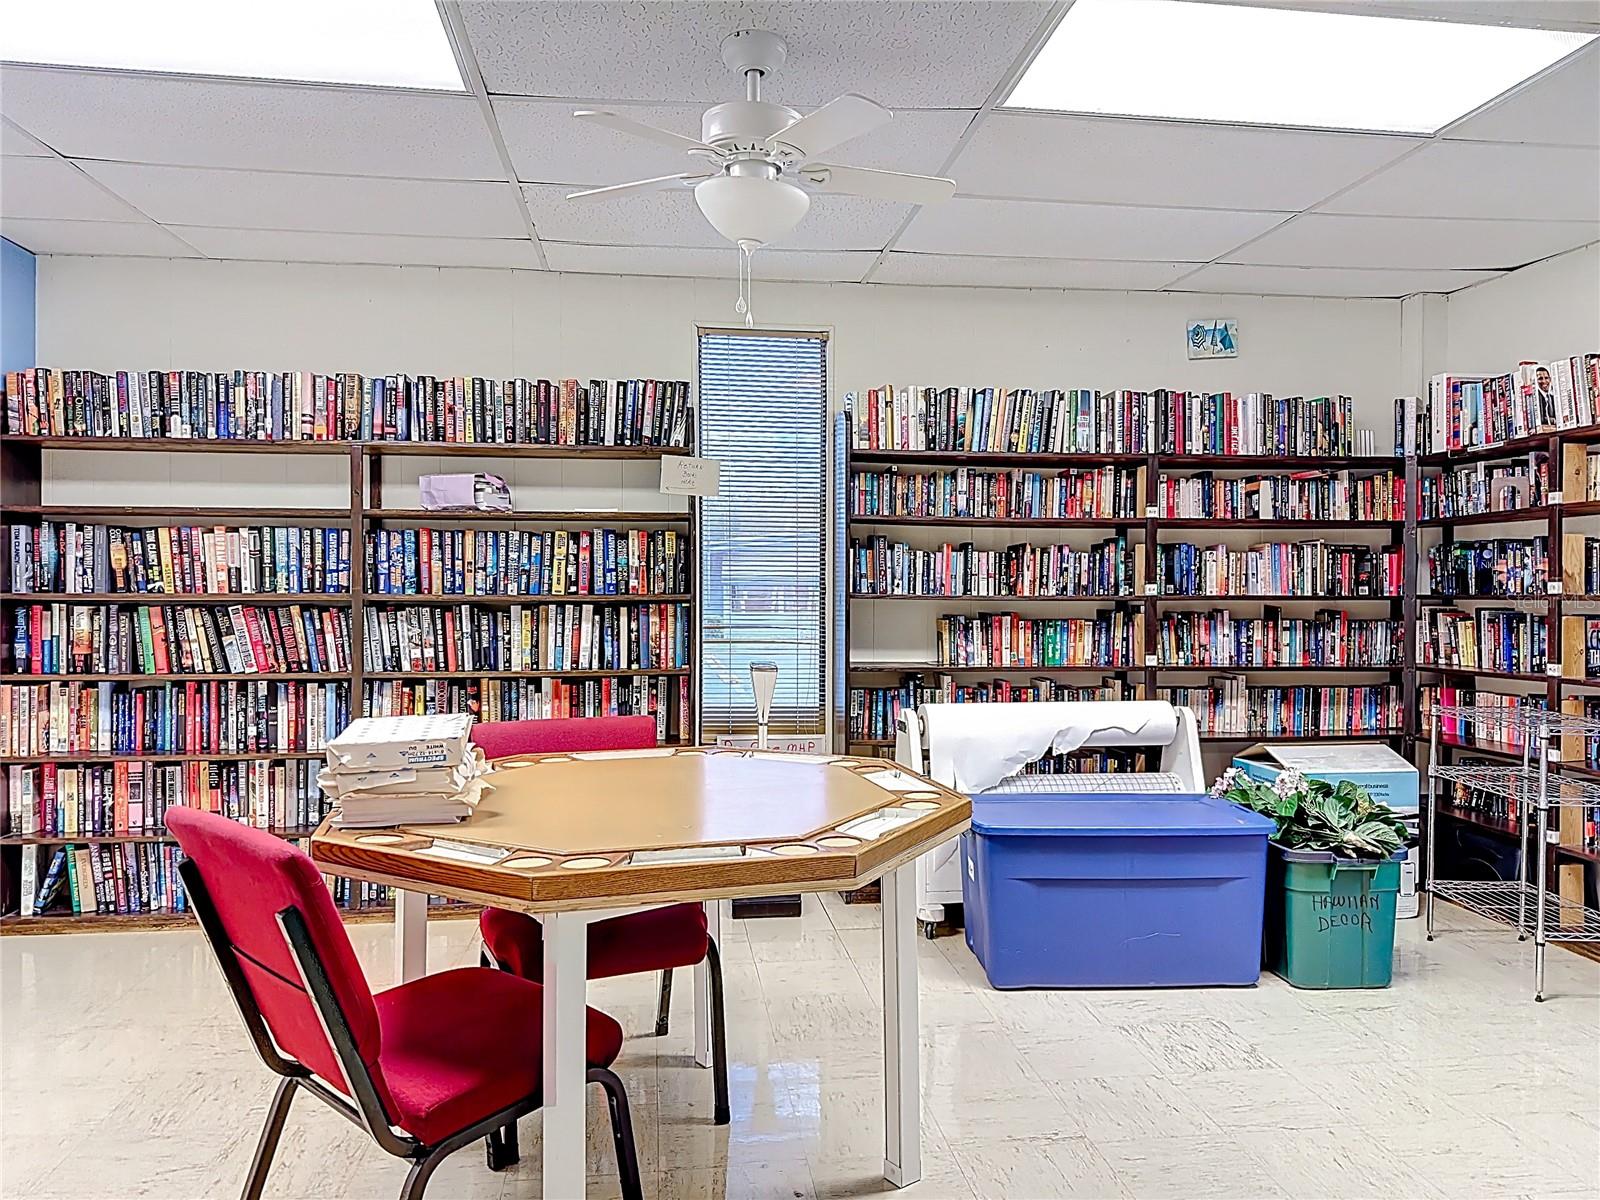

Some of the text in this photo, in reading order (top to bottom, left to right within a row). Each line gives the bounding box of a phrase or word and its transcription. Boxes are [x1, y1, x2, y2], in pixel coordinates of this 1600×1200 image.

[507, 429, 512, 440] 6
[146, 530, 158, 565] TOM CLANCY
[176, 611, 188, 640] COLOSSUS
[201, 611, 222, 668] JOSEPH FINDER VANISHED
[389, 623, 397, 646] GARDNER
[282, 626, 299, 662] GRAND JURY
[91, 845, 100, 862] ANNE
